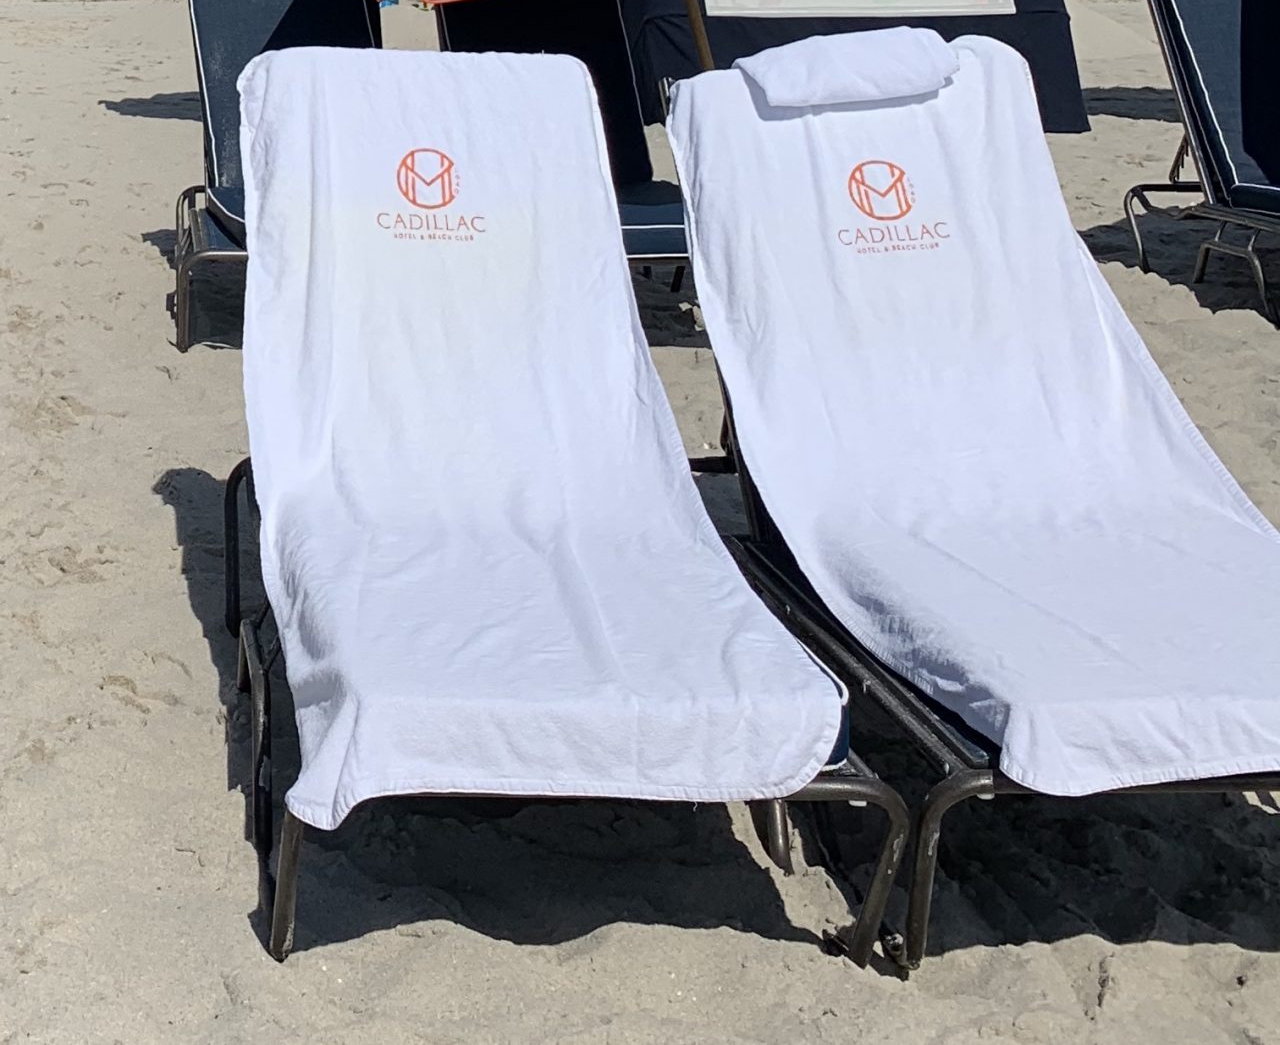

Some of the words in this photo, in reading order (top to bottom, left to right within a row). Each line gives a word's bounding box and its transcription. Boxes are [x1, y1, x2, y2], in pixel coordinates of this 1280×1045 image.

[377, 212, 486, 233] CADILLAC
[393, 233, 417, 241] HOTEL
[454, 234, 474, 242] CLUB
[838, 222, 951, 246] CADILLAC
[857, 247, 881, 255] HOTEL
[919, 242, 940, 250] CLUB
